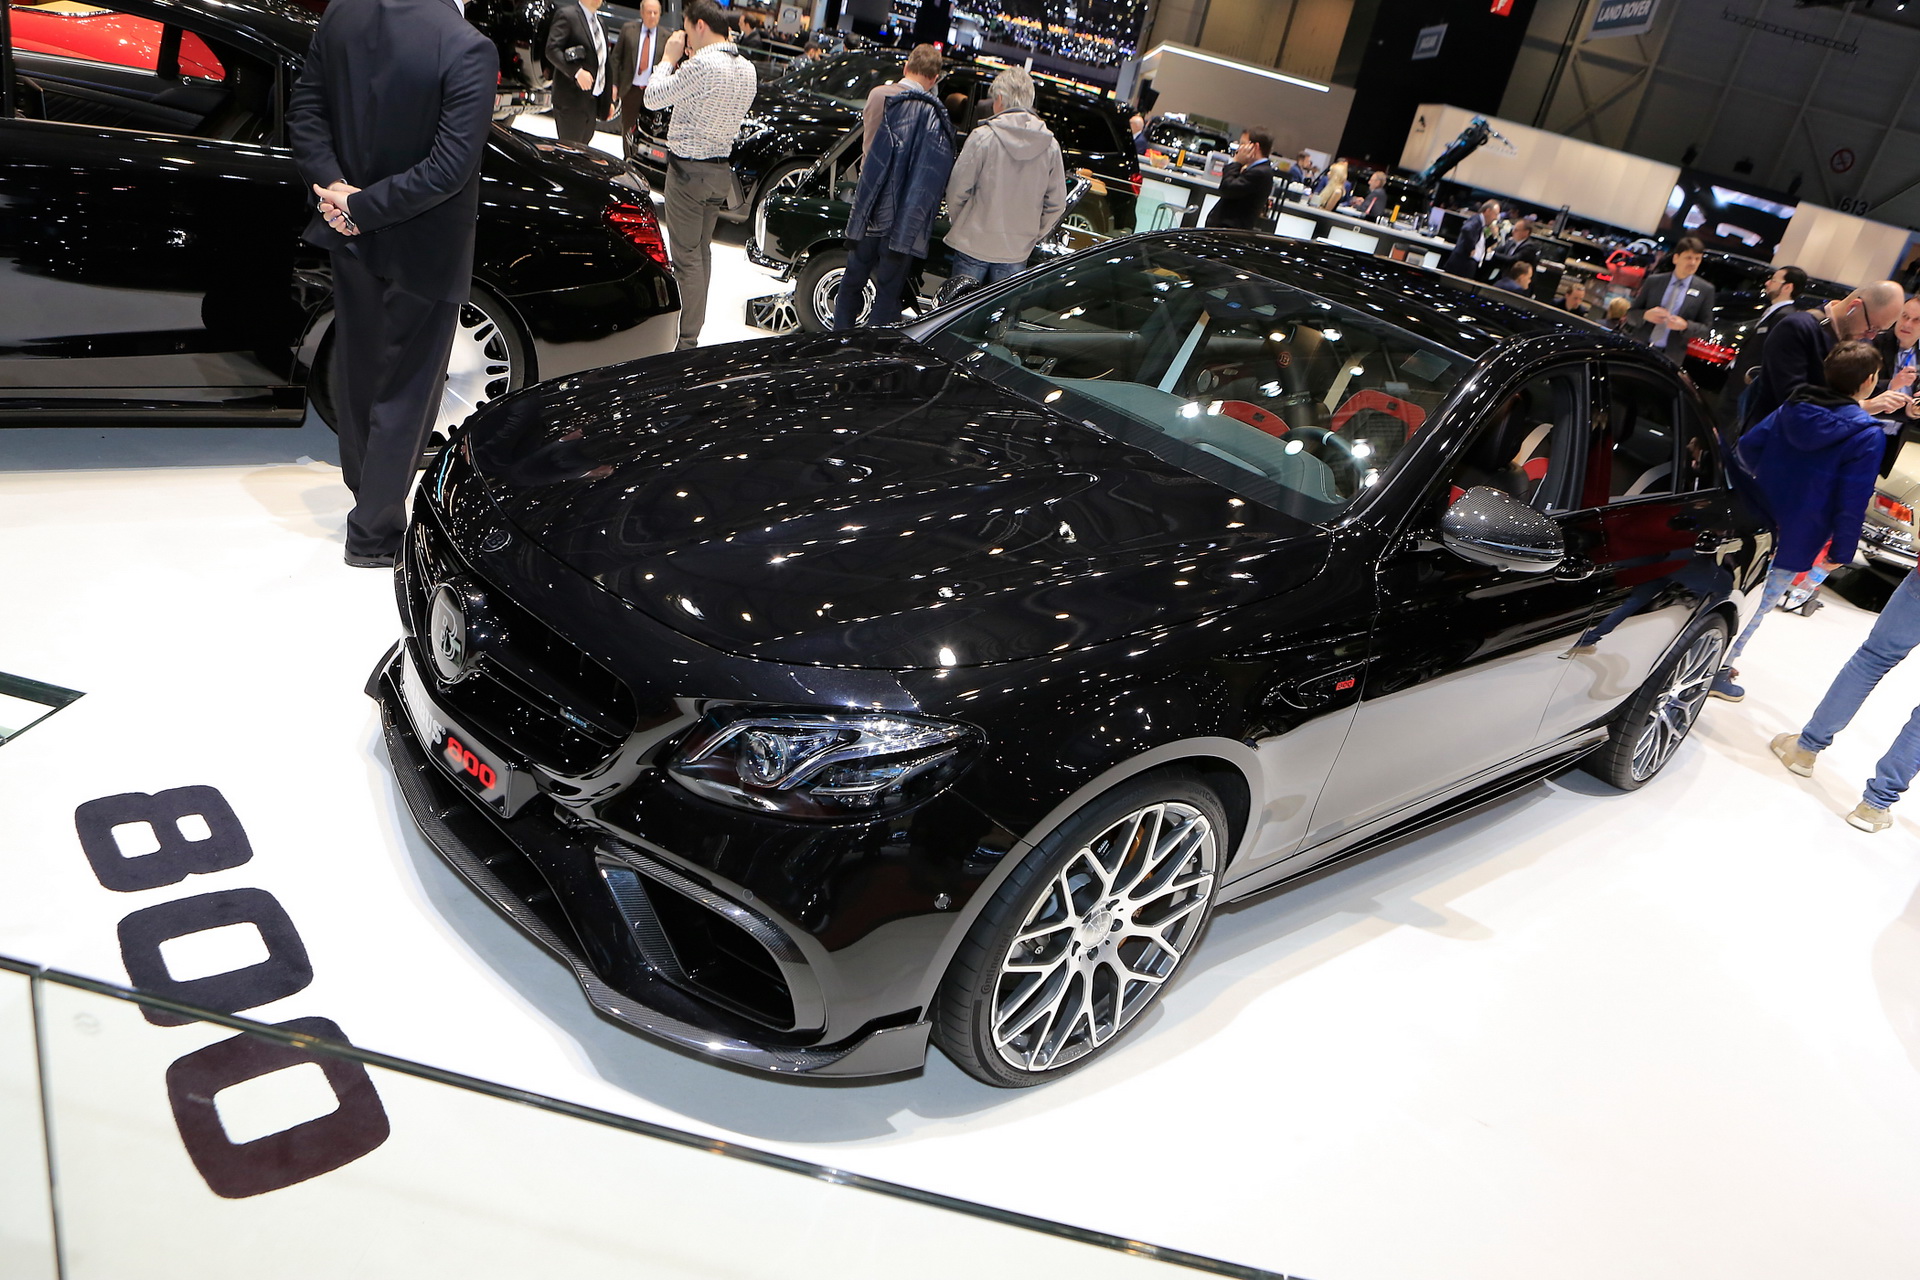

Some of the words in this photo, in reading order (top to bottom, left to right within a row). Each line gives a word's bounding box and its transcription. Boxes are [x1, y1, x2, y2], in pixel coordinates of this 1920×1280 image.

[1597, 4, 1622, 22] LAND
[1620, 0, 1651, 19] ROVER
[1840, 197, 1868, 216] 613
[405, 664, 442, 744] BRABUS
[447, 737, 497, 790] 800
[74, 784, 391, 1199] 800
[981, 932, 1012, 995] Continental
